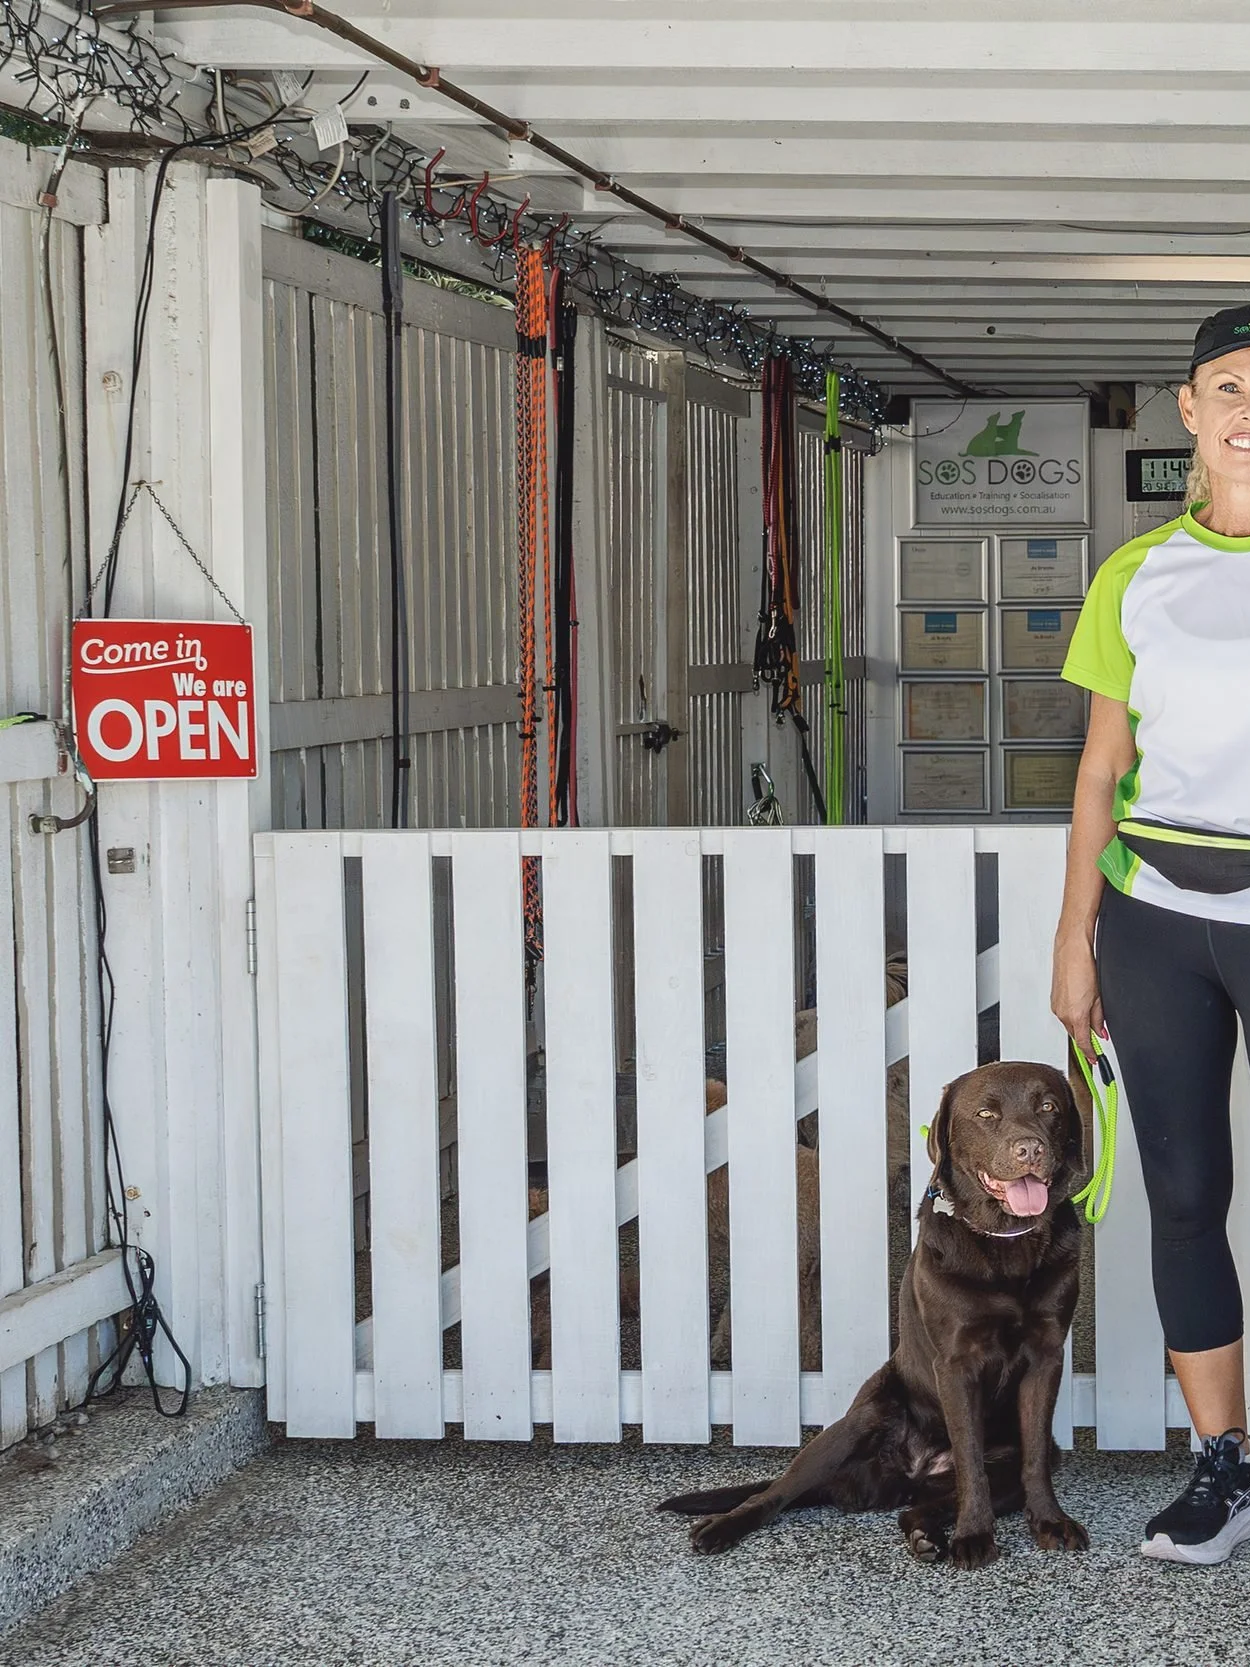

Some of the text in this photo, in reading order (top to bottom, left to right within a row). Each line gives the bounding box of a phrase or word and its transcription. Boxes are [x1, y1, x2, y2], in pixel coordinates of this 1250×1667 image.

[918, 459, 1082, 486] SOS DOGS
[930, 491, 1071, 502] Education Training Socialisation
[941, 504, 1056, 517] www.sosdogs.com.au
[80, 633, 204, 665] Come in
[172, 672, 247, 697] We are
[87, 698, 250, 763] OPEN
